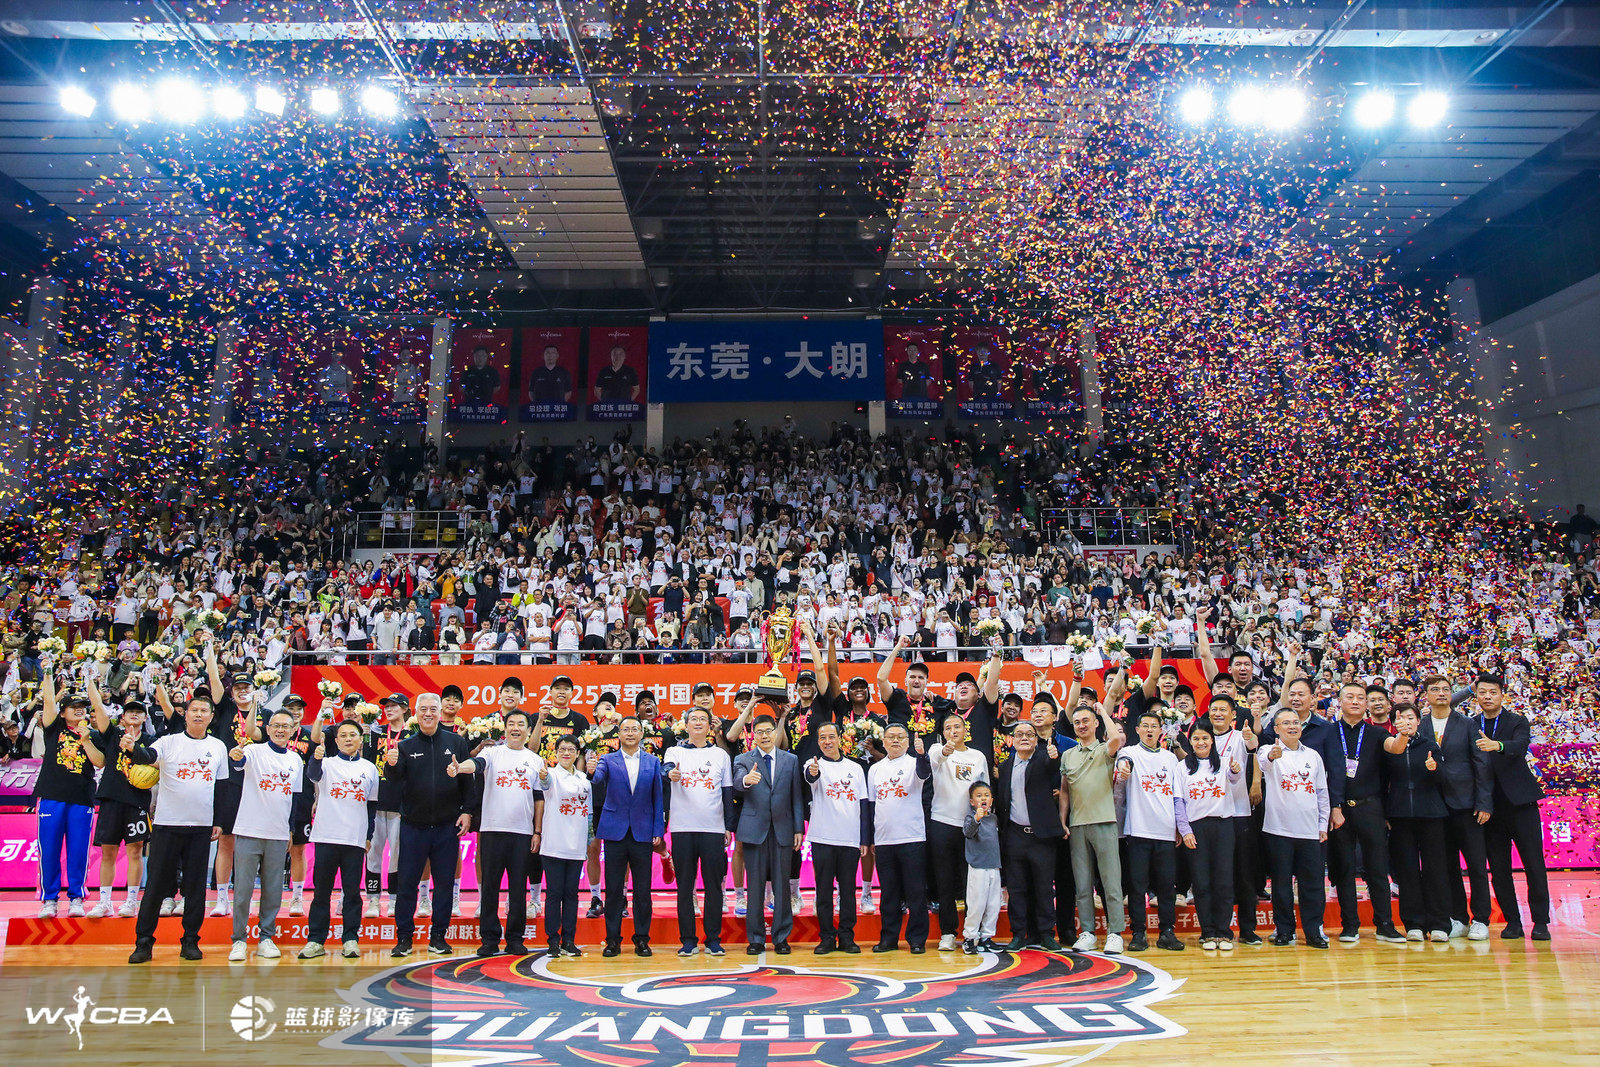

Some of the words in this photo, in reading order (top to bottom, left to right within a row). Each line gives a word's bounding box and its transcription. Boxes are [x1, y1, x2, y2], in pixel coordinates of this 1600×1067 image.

[666, 341, 868, 380] 东莞·大朗
[127, 820, 147, 837] 30
[368, 879, 379, 889] 22
